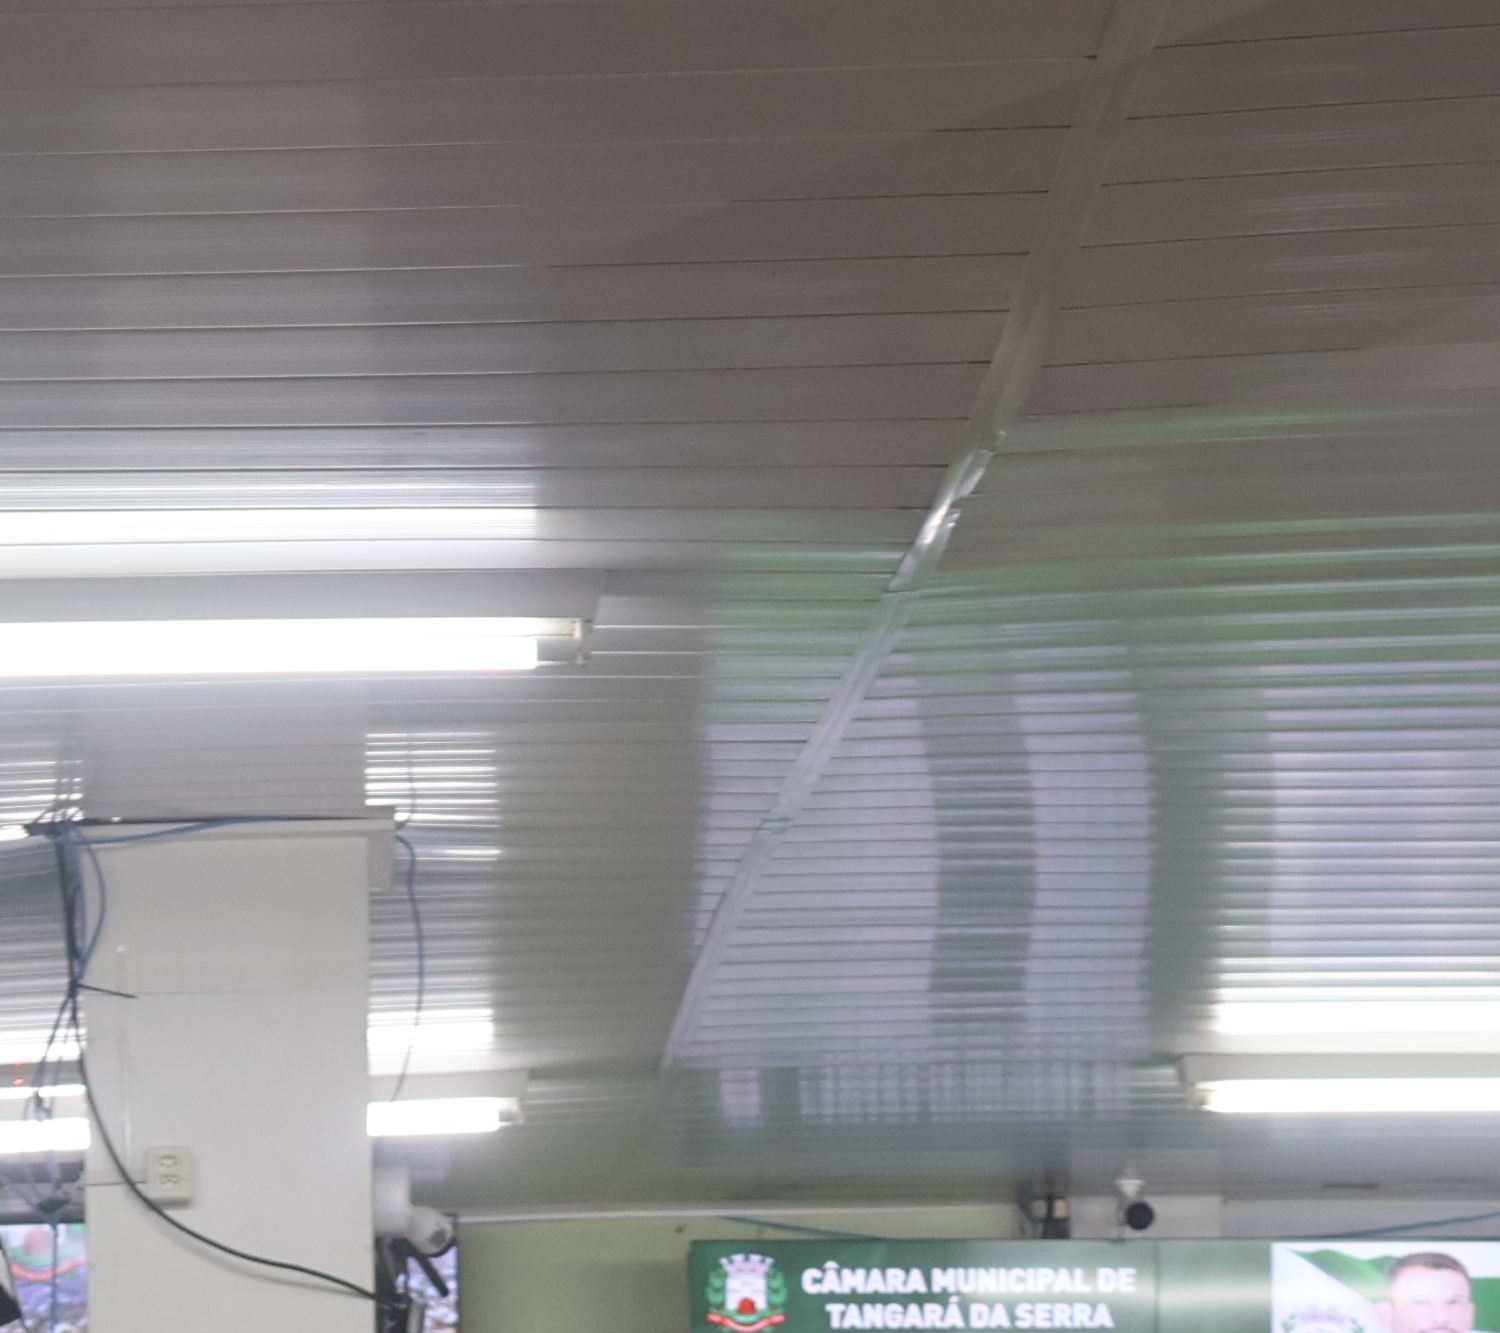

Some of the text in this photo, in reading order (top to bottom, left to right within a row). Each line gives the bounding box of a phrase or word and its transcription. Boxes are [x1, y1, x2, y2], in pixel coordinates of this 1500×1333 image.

[801, 1261, 1137, 1294] CÂMARA MUNICIPAL DE
[825, 1296, 1115, 1328] TANGARÁ DA SERRA
